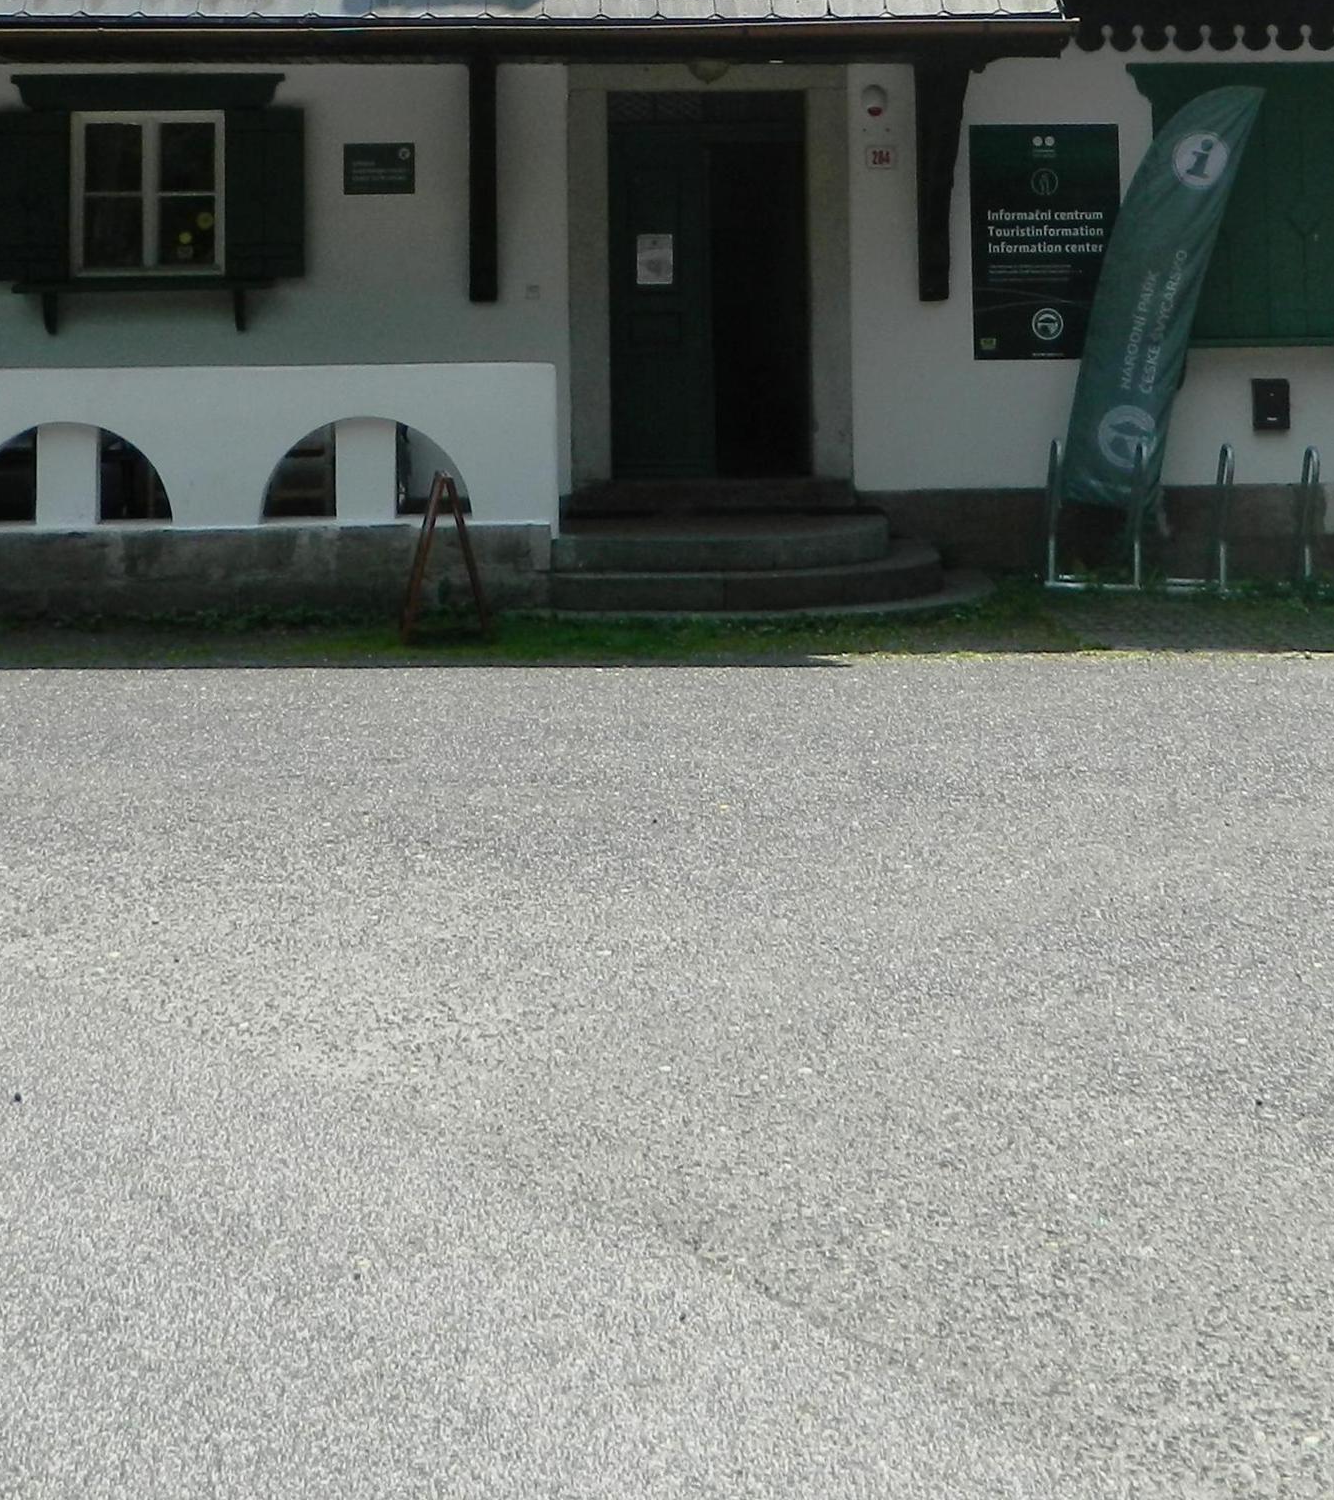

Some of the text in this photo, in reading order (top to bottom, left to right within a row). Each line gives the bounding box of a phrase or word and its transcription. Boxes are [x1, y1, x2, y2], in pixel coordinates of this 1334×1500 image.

[1054, 210, 1103, 220] centrum
[987, 224, 1104, 237] Touristinformation
[988, 241, 1104, 253] Information center
